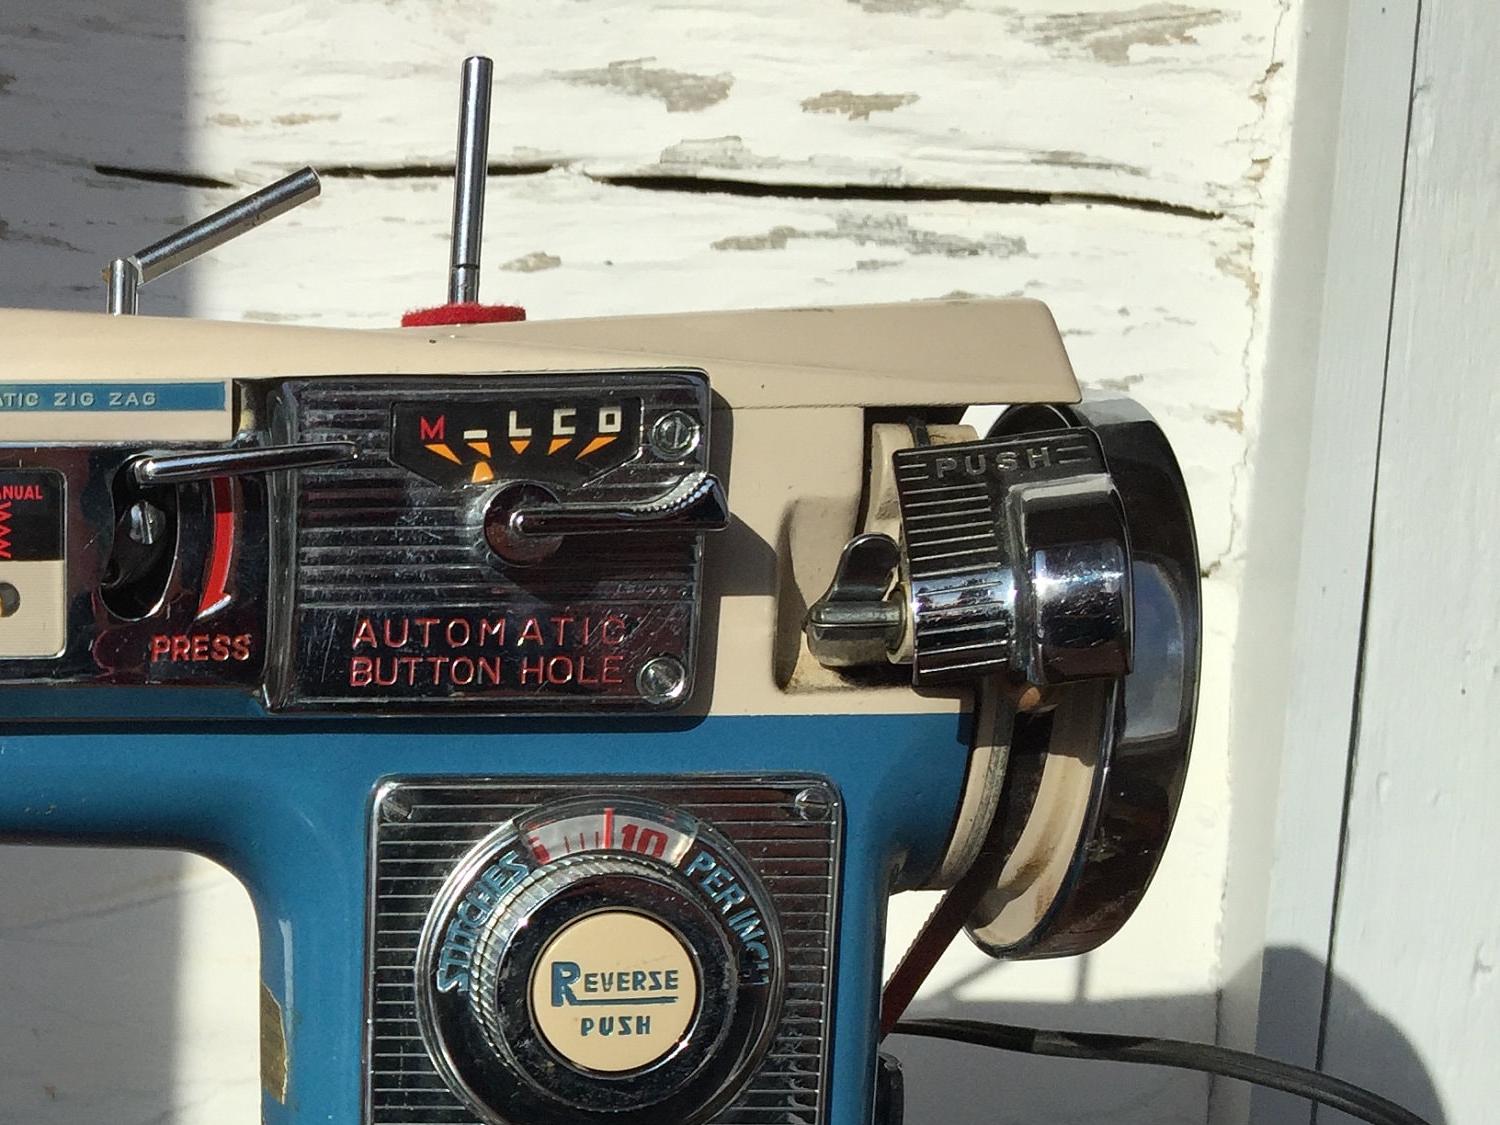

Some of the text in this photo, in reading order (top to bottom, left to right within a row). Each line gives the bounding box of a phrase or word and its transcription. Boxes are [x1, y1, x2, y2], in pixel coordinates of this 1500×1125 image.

[54, 392, 95, 407] ZIG
[109, 391, 157, 406] ZAG
[420, 415, 445, 440] M
[934, 447, 1051, 478] PUSH
[150, 634, 252, 662] PRESS
[351, 616, 626, 649] AUTOMATIC
[350, 655, 625, 687] BUTTON HOLE
[620, 823, 669, 858] 10
[436, 850, 531, 994] STITCHES
[682, 850, 745, 914] PER
[551, 961, 679, 1007] REVERSE
[581, 1015, 651, 1037] PUSH
